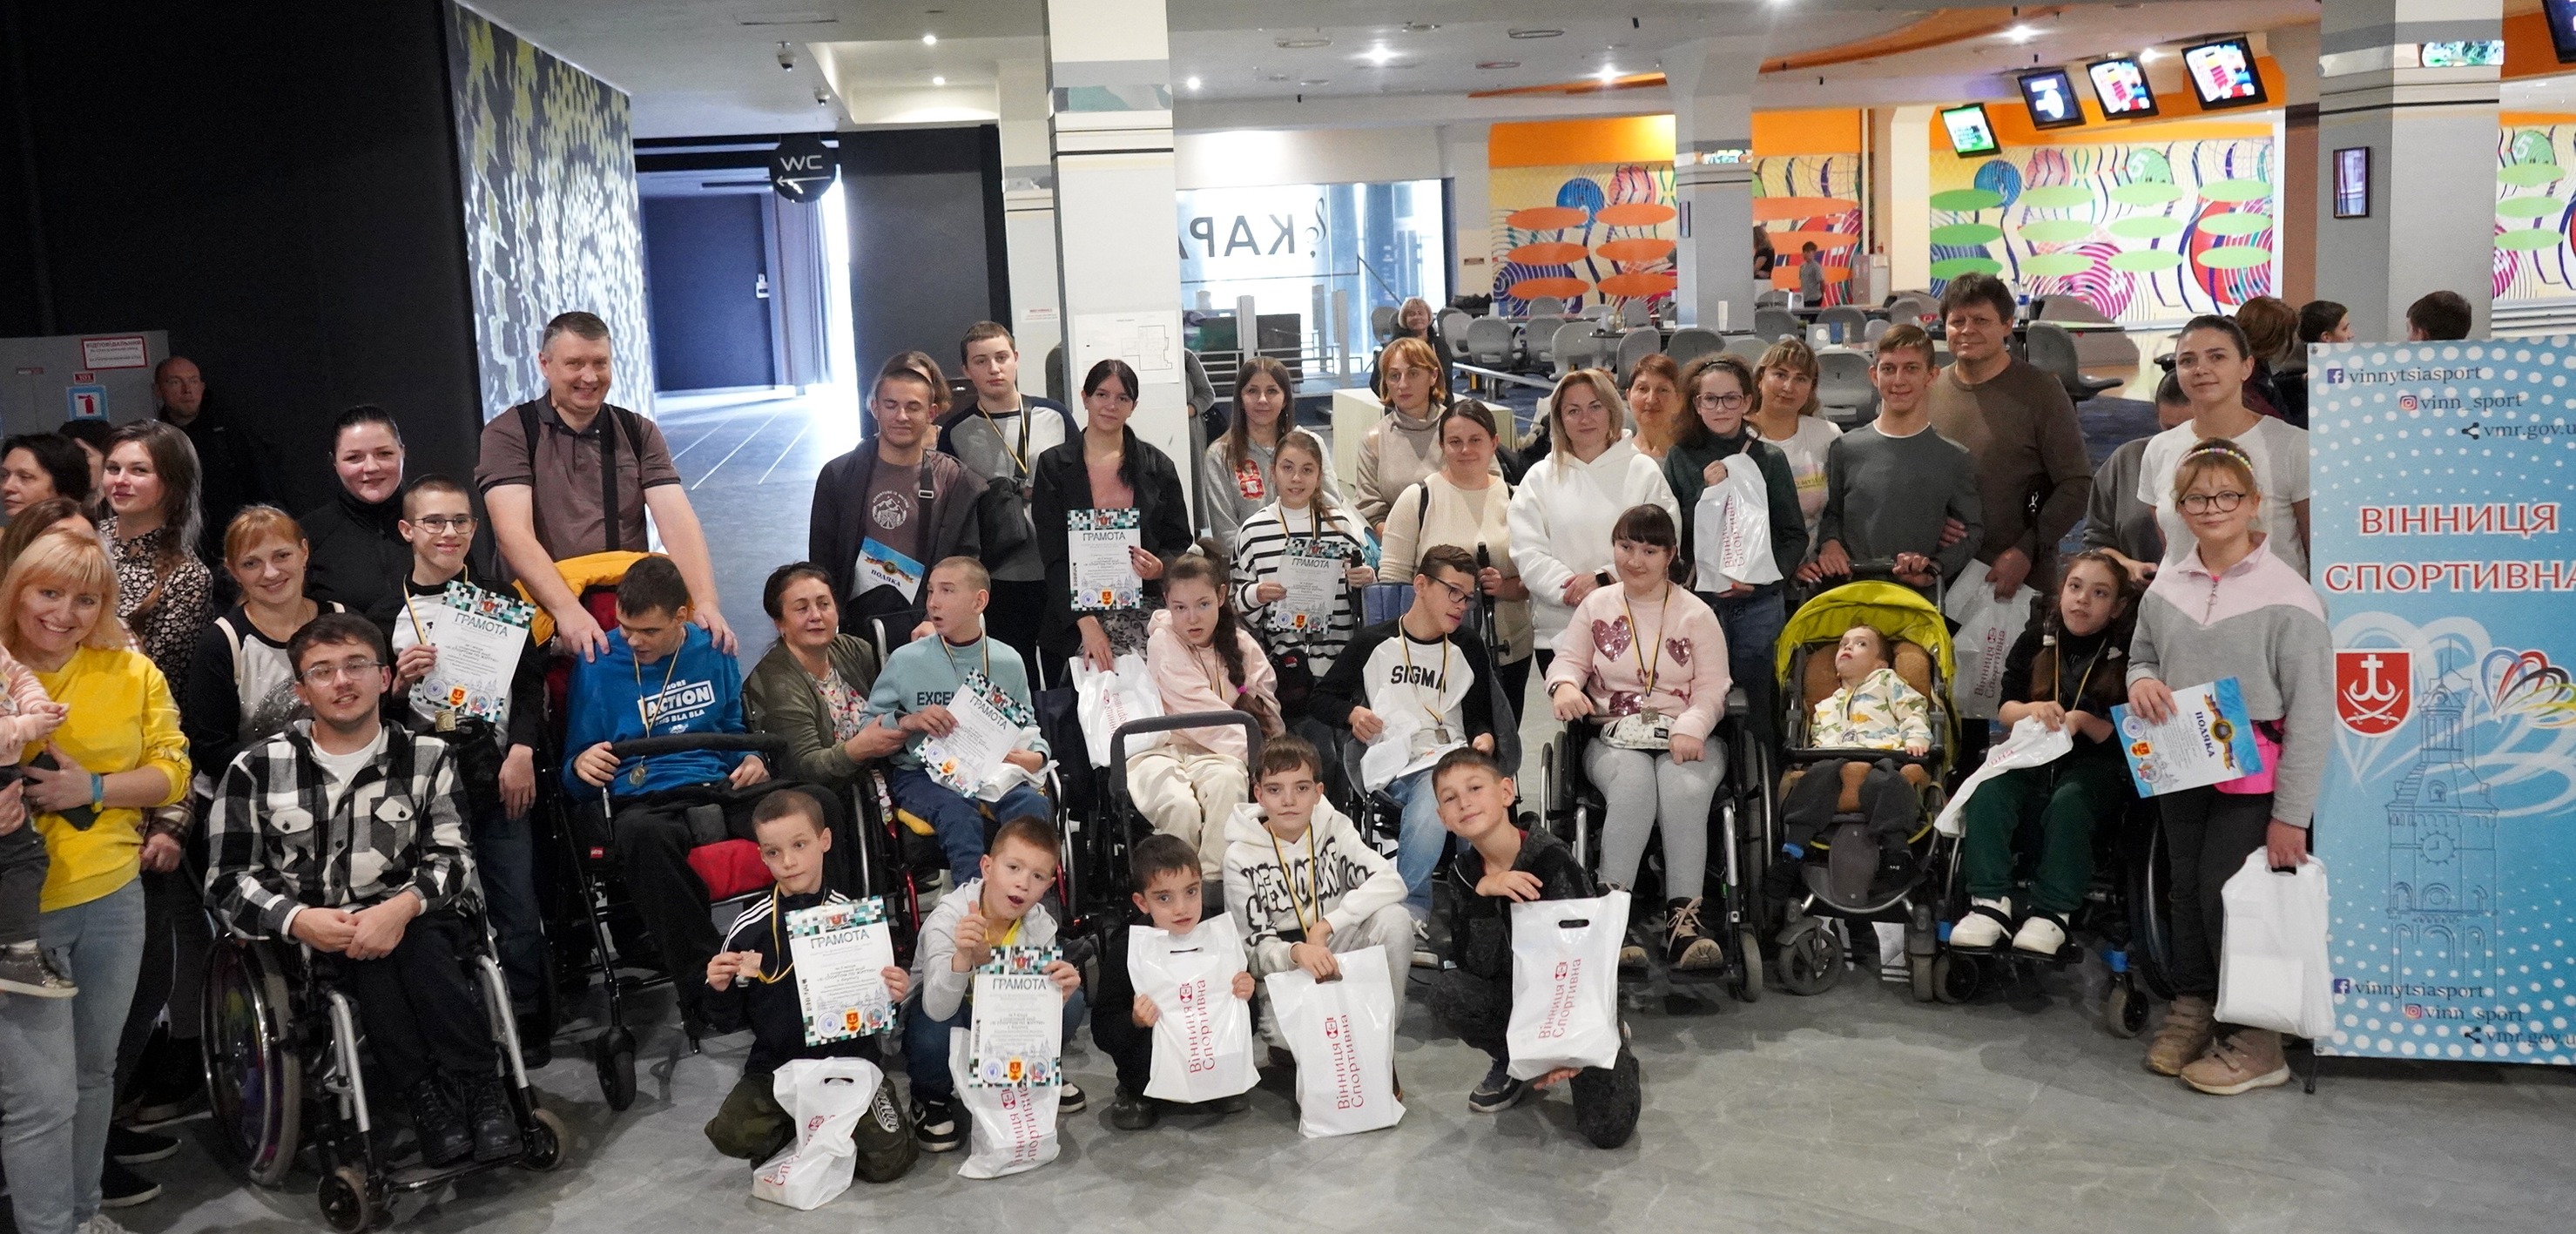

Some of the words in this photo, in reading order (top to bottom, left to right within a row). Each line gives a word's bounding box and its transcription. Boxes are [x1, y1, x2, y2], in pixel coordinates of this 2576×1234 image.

[779, 154, 823, 172] WC
[2350, 367, 2482, 387] vinnytsiasport
[2420, 393, 2523, 411] vinn_sport
[2360, 503, 2559, 537] ВІННИЦЯ
[1082, 531, 1126, 541] ГРАМОТА
[1292, 557, 1330, 569] ГРАМОТА
[871, 569, 901, 587] ПОДЯКА
[454, 612, 508, 637] ГРАМОТА
[1391, 665, 1446, 693] SIGMA
[647, 686, 711, 718] ACTION
[968, 695, 1008, 731] ГРАМОТА
[671, 713, 688, 722] BLA
[688, 709, 705, 718] BLA
[2195, 711, 2215, 759] ПОДЯКА
[810, 928, 870, 950] ГРАМОТА
[992, 978, 1047, 990] ГРАМОТА
[2355, 981, 2485, 1001] vinnytsiasport
[1552, 959, 1581, 1038] Спортивна
[1538, 984, 1565, 1039] Вінниця
[2424, 1005, 2525, 1024] vinn_sport
[1197, 980, 1216, 1070] Спортивна
[1183, 1006, 1203, 1073] Вінниця
[1341, 1015, 1365, 1108] Спортивна
[1332, 1042, 1351, 1109] Вінниця
